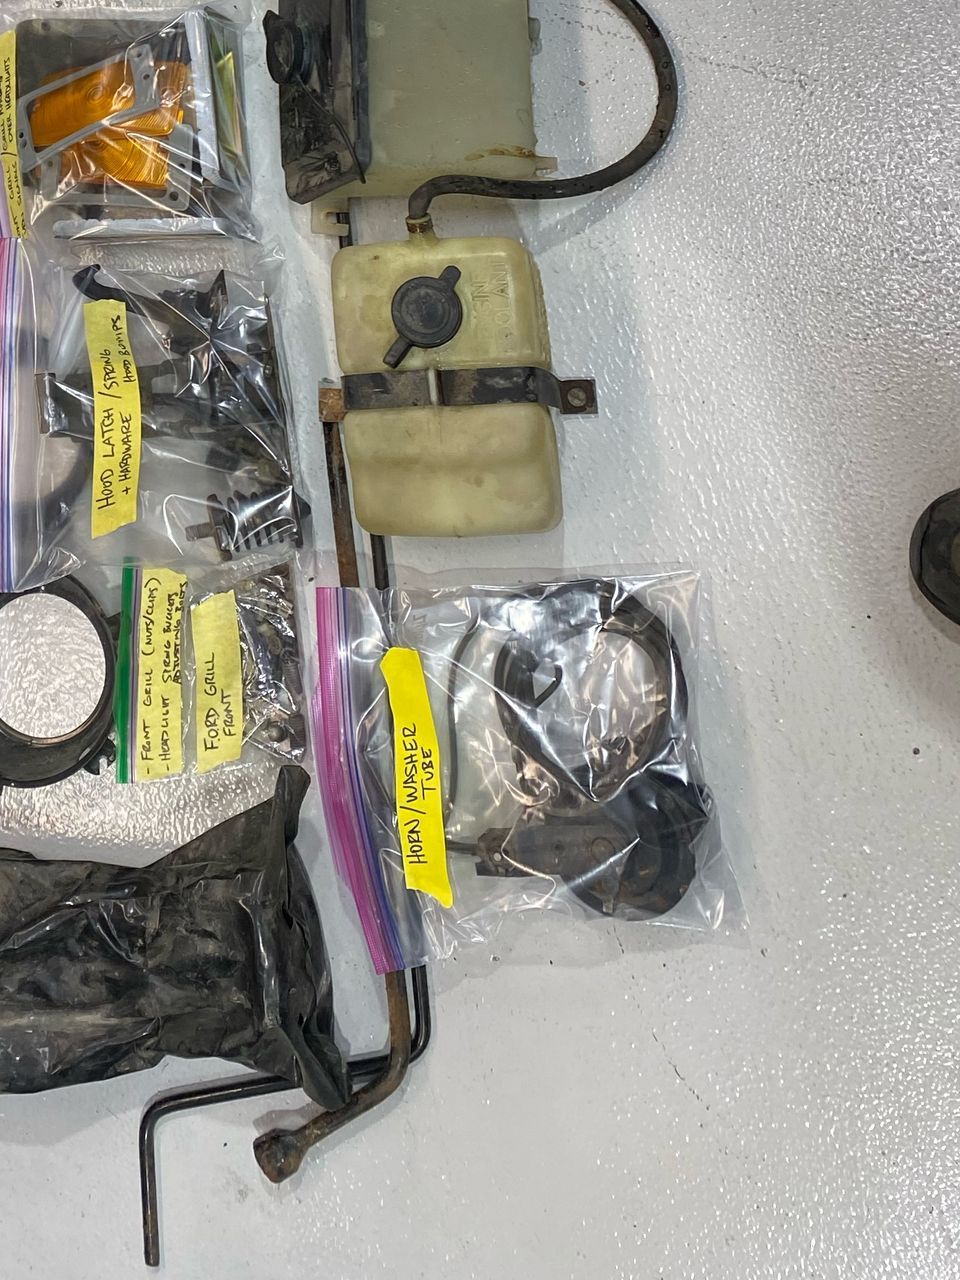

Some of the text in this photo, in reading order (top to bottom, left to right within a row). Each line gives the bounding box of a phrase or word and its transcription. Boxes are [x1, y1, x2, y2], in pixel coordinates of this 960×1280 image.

[99, 348, 119, 391] SPRING
[123, 359, 136, 383] HOOD
[100, 407, 115, 458] LATCH
[118, 412, 133, 483] HARDWARE
[96, 468, 116, 510] HOOD
[143, 669, 154, 707] GRILL
[204, 652, 217, 696] GRILL
[220, 688, 237, 737] FRONT
[141, 724, 154, 762] FRONT
[421, 747, 437, 800] TUBE
